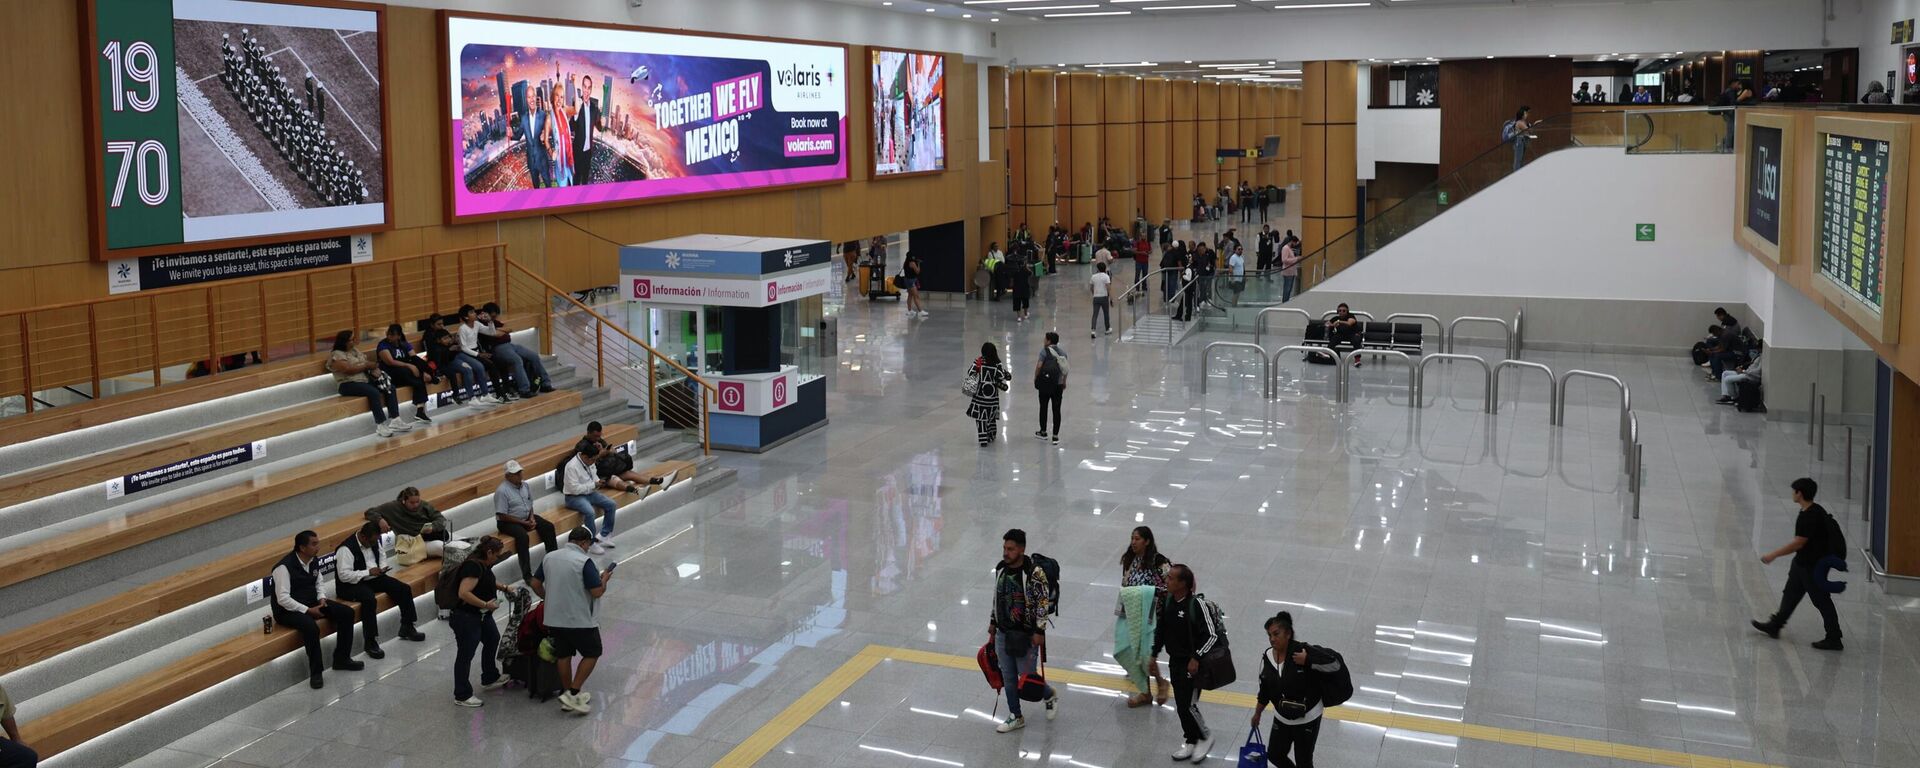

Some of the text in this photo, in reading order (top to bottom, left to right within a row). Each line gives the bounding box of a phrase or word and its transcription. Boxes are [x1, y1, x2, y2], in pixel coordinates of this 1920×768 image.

[103, 41, 159, 112] 19
[777, 63, 821, 86] volaris
[654, 76, 759, 130] TOGETHER WE FLY
[797, 91, 821, 99] AIRLINES
[791, 117, 828, 129] Book now at
[685, 118, 739, 165] MEXICO
[787, 138, 832, 152] volaris.com
[107, 140, 169, 207] 70
[166, 254, 207, 267] invitamos
[214, 249, 251, 261] sentarte!,
[252, 247, 267, 258] este
[268, 244, 295, 257] espacio
[296, 244, 304, 252] es
[304, 242, 320, 254] para
[320, 240, 341, 250] todos.
[169, 254, 329, 280] We invite you to take a seat, this space is for everyone
[652, 285, 750, 299] Información / Information
[777, 281, 802, 295] Información
